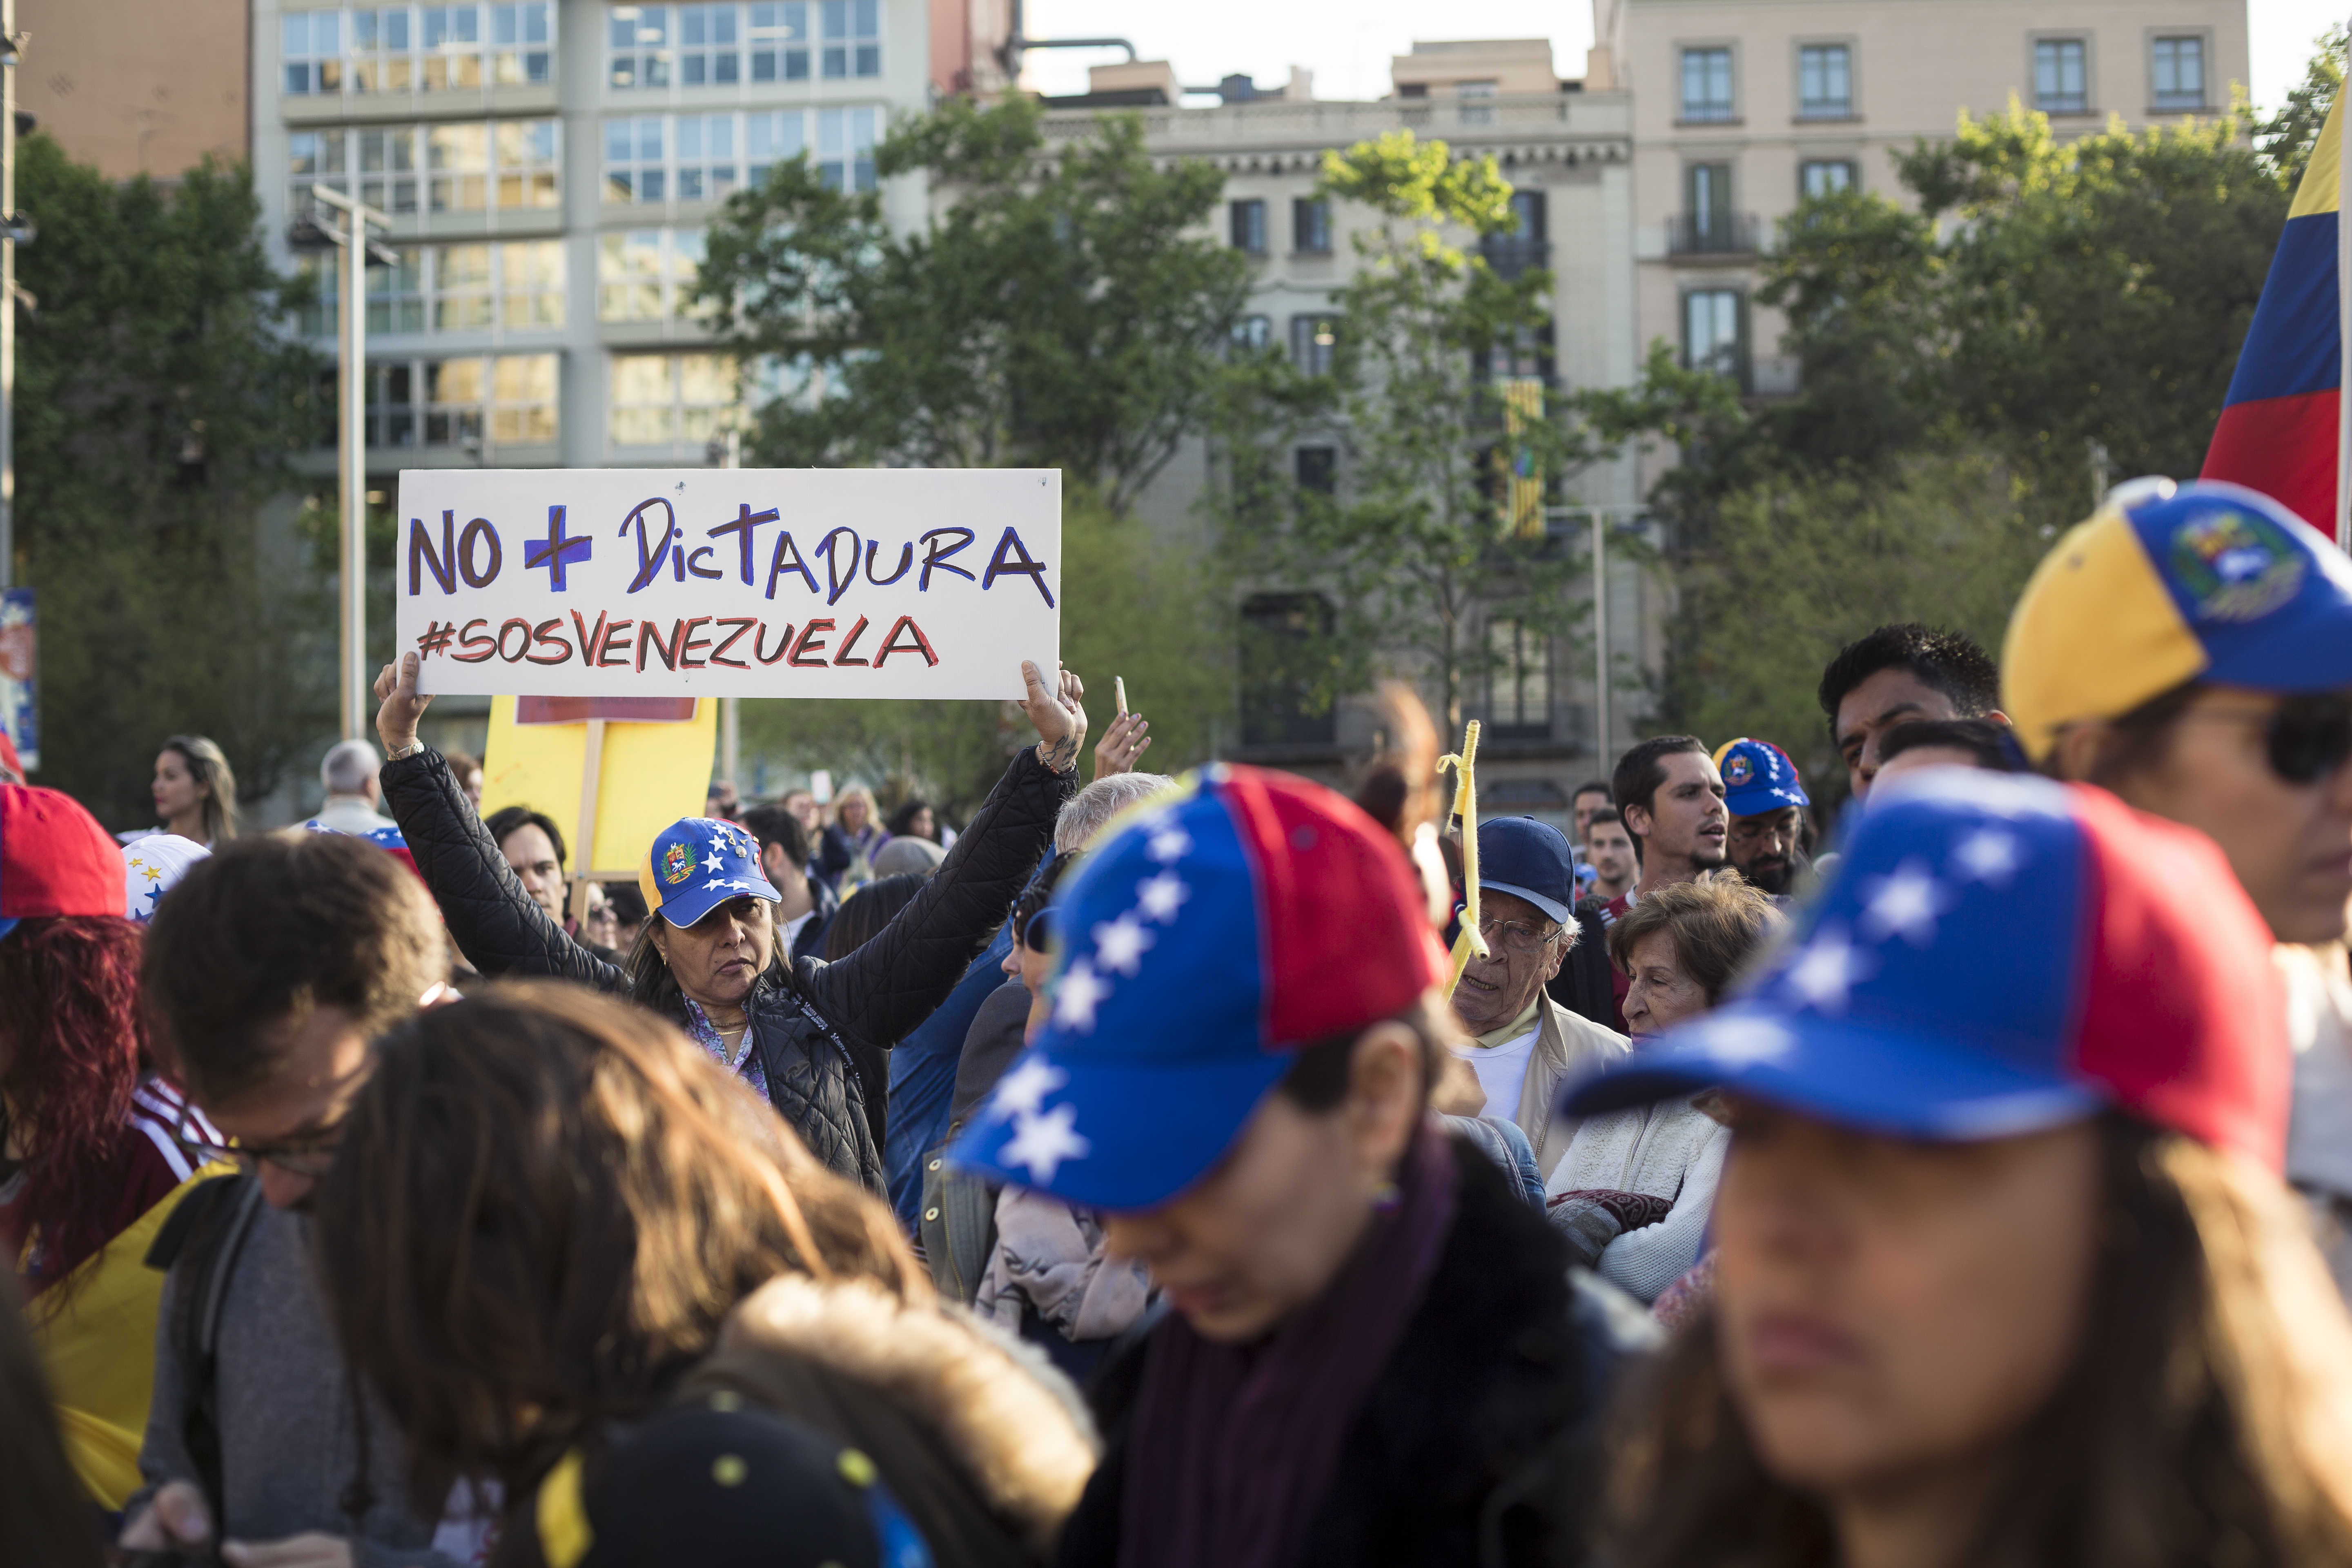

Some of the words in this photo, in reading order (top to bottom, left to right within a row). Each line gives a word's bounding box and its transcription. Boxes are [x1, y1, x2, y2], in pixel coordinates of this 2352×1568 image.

[409, 510, 502, 596] NO
[524, 506, 592, 592] +
[417, 608, 939, 674] #SOSVENEZUELA
